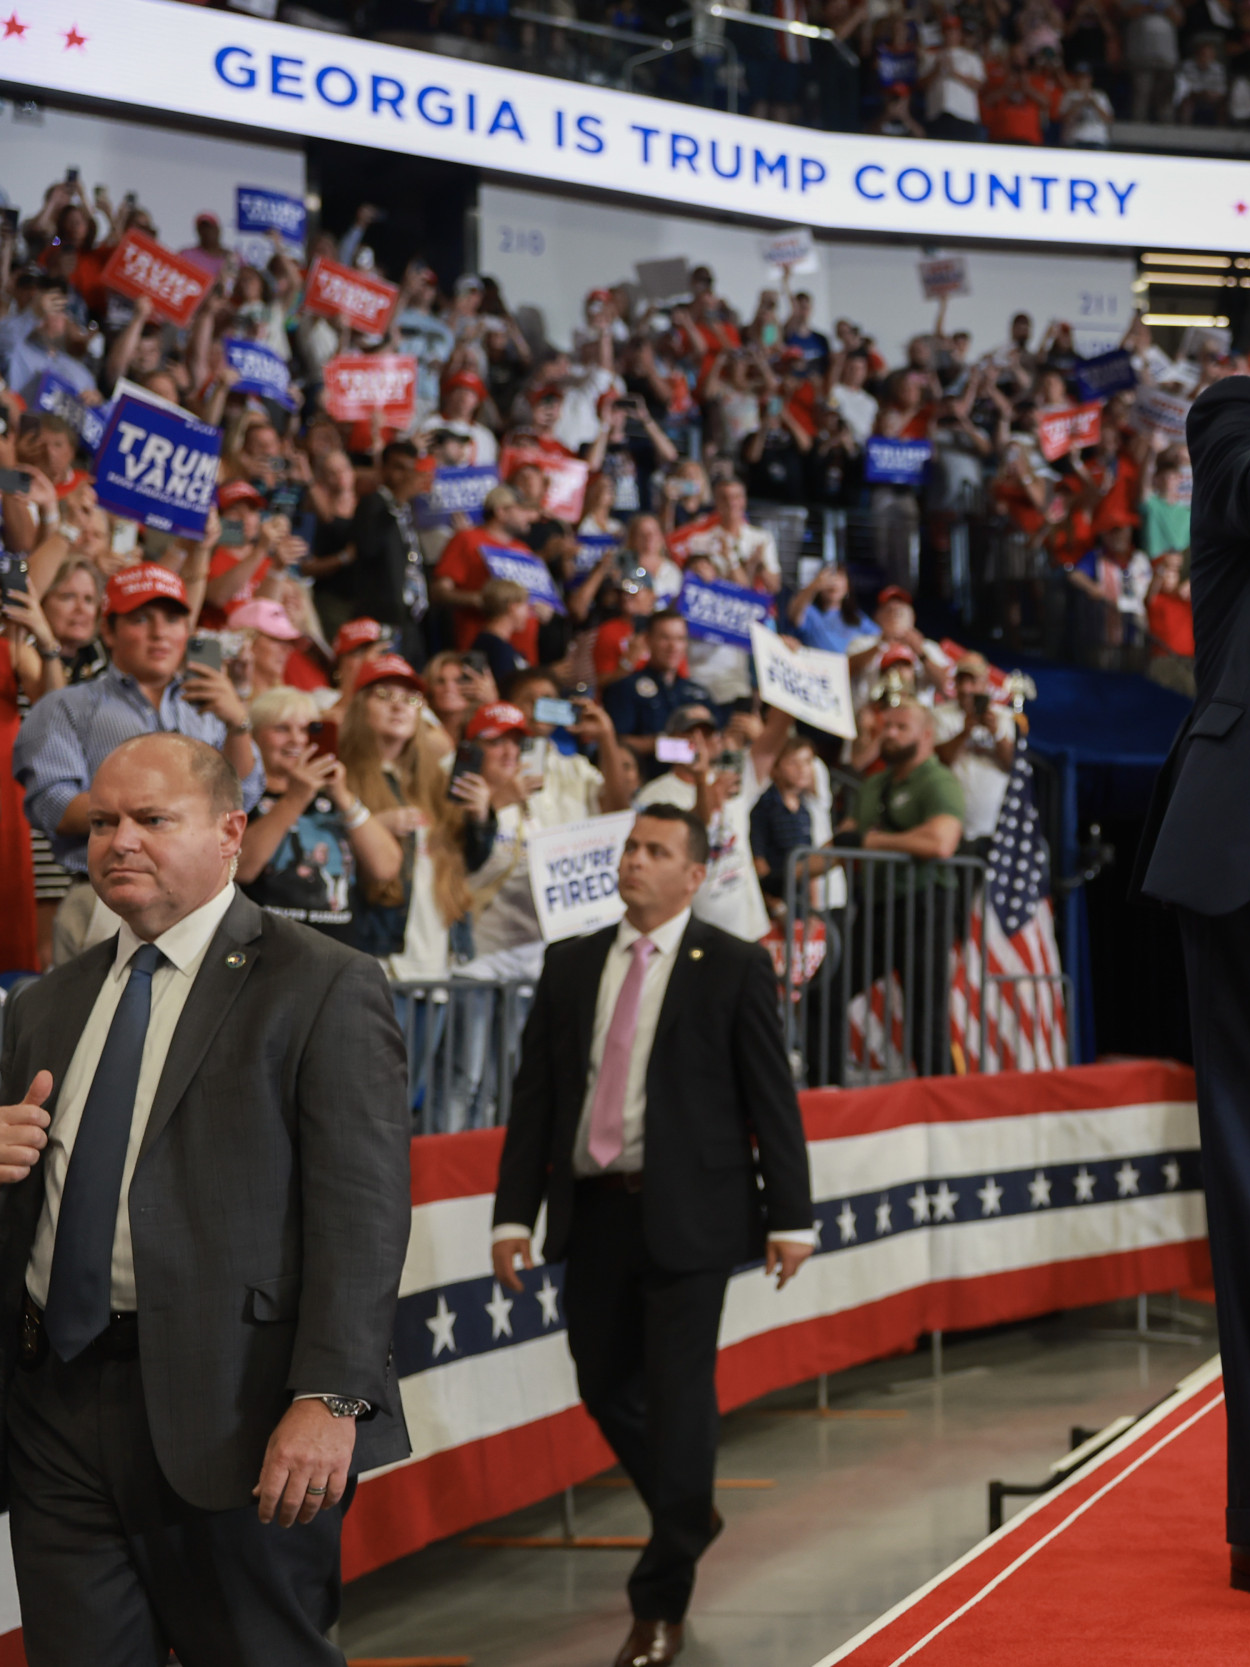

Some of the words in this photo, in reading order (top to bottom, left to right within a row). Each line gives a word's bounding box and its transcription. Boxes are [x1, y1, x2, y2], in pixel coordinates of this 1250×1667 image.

[213, 44, 527, 143] GEORGIA
[554, 108, 607, 157] IS
[629, 124, 829, 193] TRUMP
[853, 163, 1138, 217] COUNTRY
[124, 242, 202, 300] TRUMP
[124, 259, 190, 308] VANCE
[317, 268, 391, 310] TRUMP
[118, 420, 221, 482] TRUM
[868, 444, 931, 462] TRUMP
[685, 583, 767, 620] TRUMP
[546, 846, 615, 881] YOU'RE
[545, 871, 619, 915] FIRED
